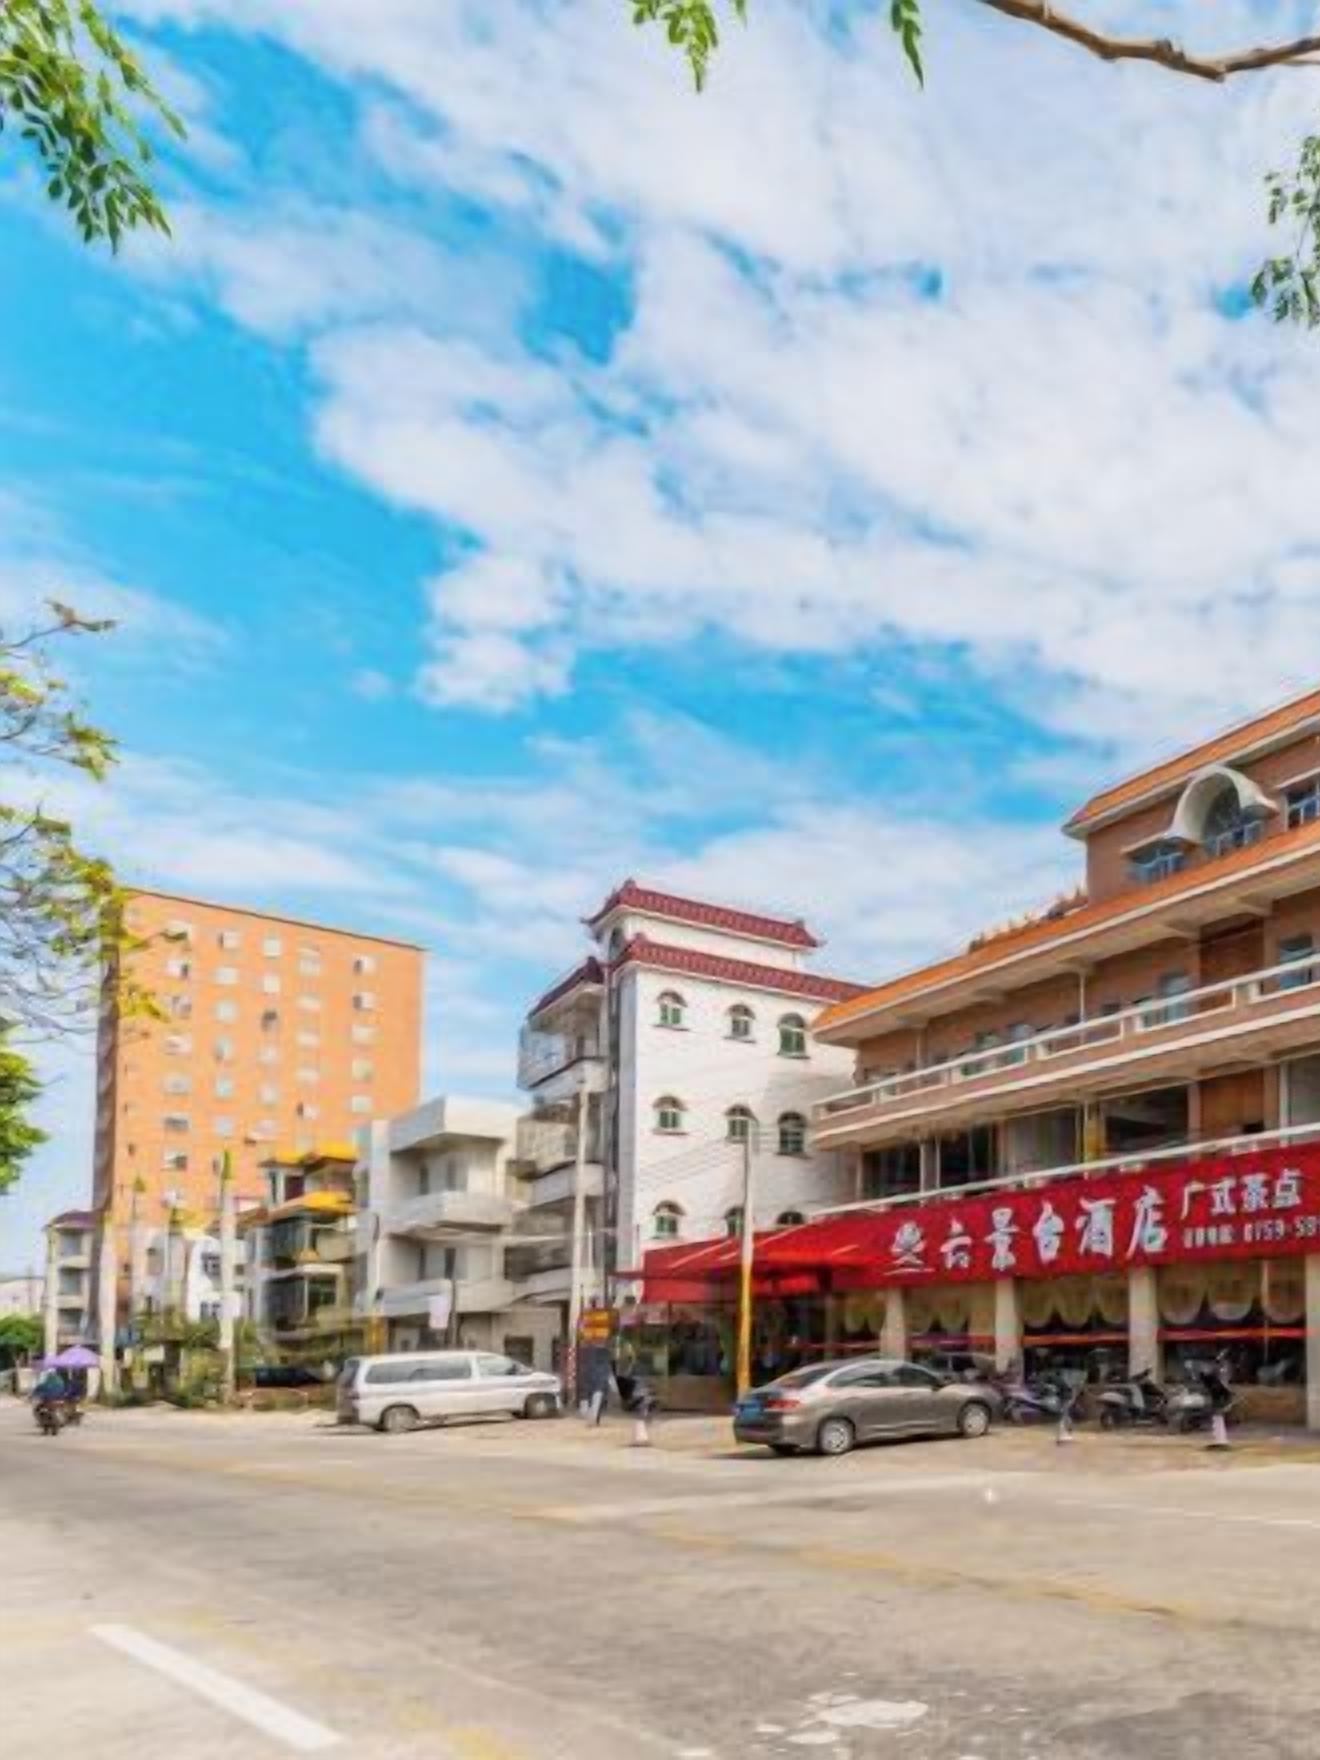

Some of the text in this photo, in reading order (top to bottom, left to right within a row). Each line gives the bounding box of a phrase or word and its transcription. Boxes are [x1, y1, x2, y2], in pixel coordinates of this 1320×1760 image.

[940, 1185, 1168, 1272] 六景台酒店
